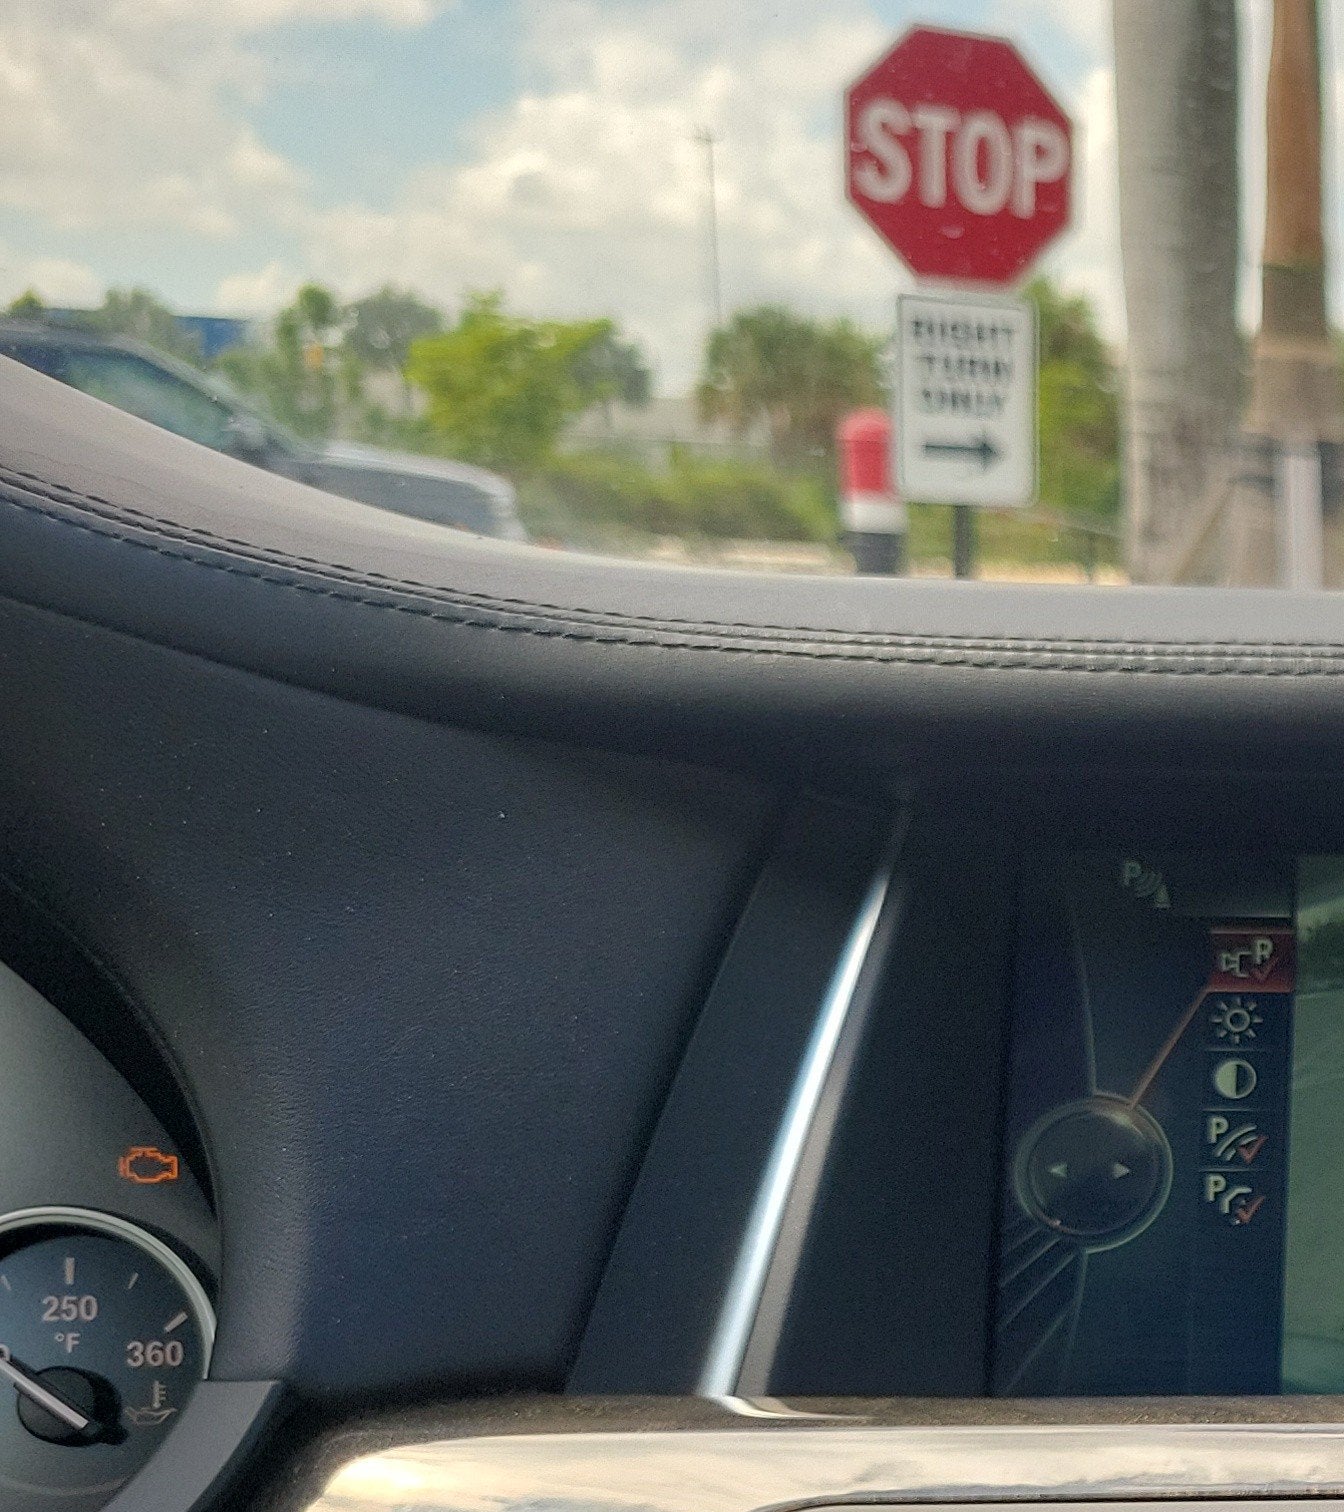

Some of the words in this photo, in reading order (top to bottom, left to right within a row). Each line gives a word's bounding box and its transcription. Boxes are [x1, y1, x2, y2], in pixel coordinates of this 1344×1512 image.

[850, 99, 1069, 219] STOP
[911, 317, 1015, 347] RIGHT
[917, 353, 1013, 382] TURN
[920, 387, 1005, 417] ONLY
[41, 1295, 99, 1322] 250
[54, 1332, 81, 1354] °F
[126, 1341, 184, 1367] 360
